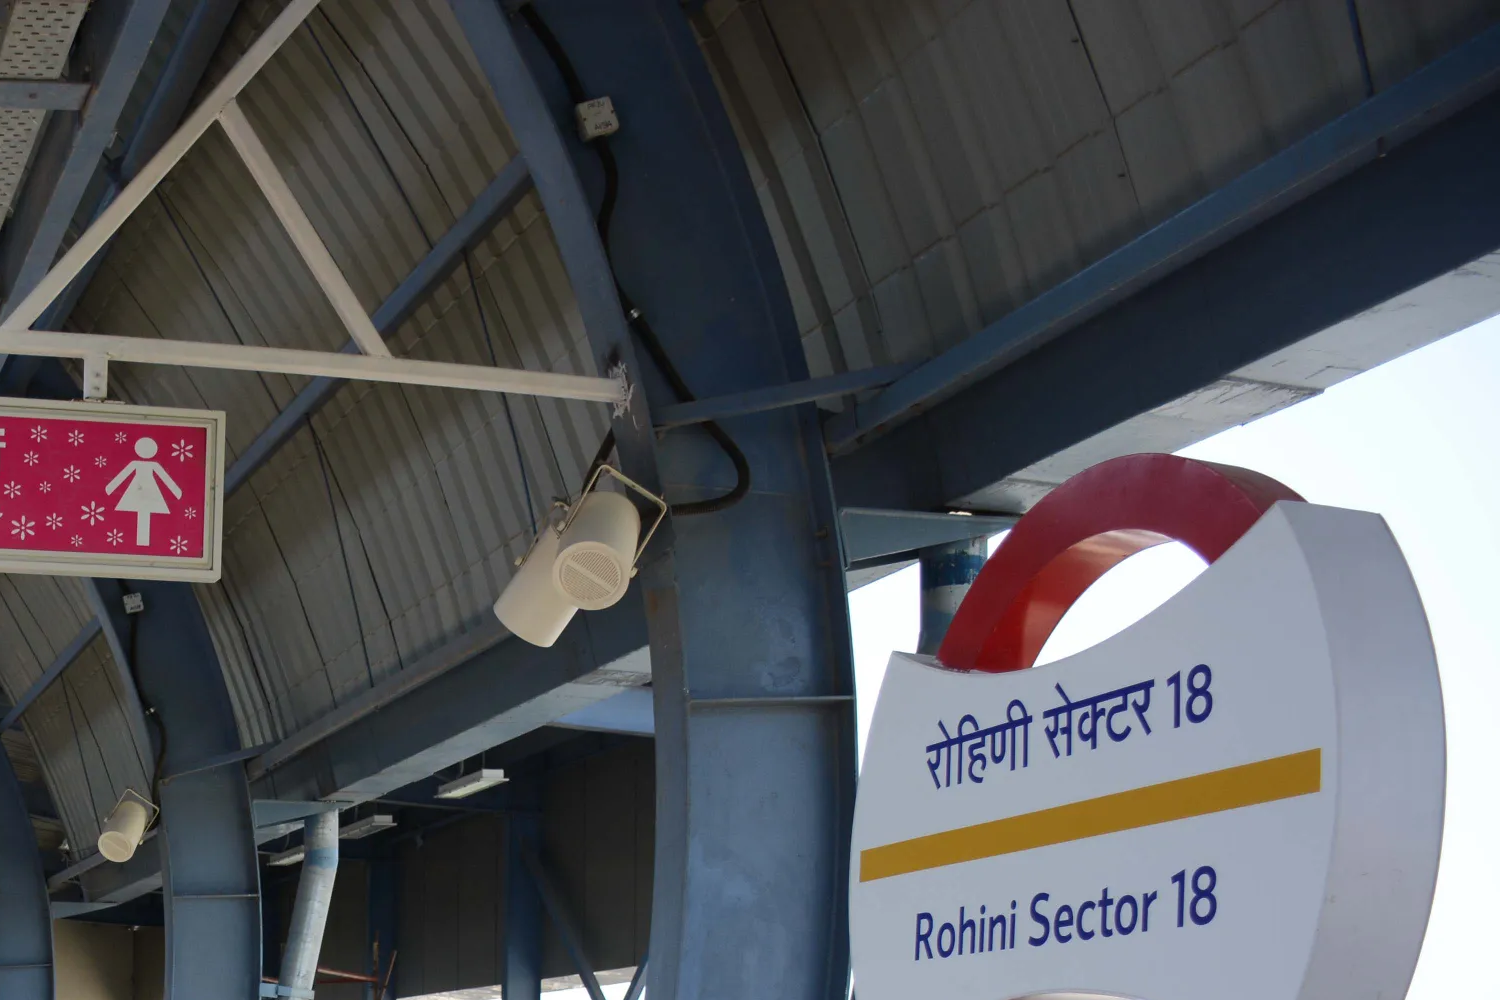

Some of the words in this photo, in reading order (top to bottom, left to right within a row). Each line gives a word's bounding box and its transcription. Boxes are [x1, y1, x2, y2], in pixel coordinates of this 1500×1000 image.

[926, 700, 1032, 789] रोहिणी
[1043, 679, 1154, 758] सेक्टर
[1167, 664, 1213, 728] 18
[915, 900, 1017, 960] Rohini
[1029, 888, 1157, 946] Sector
[1172, 866, 1218, 927] 18
